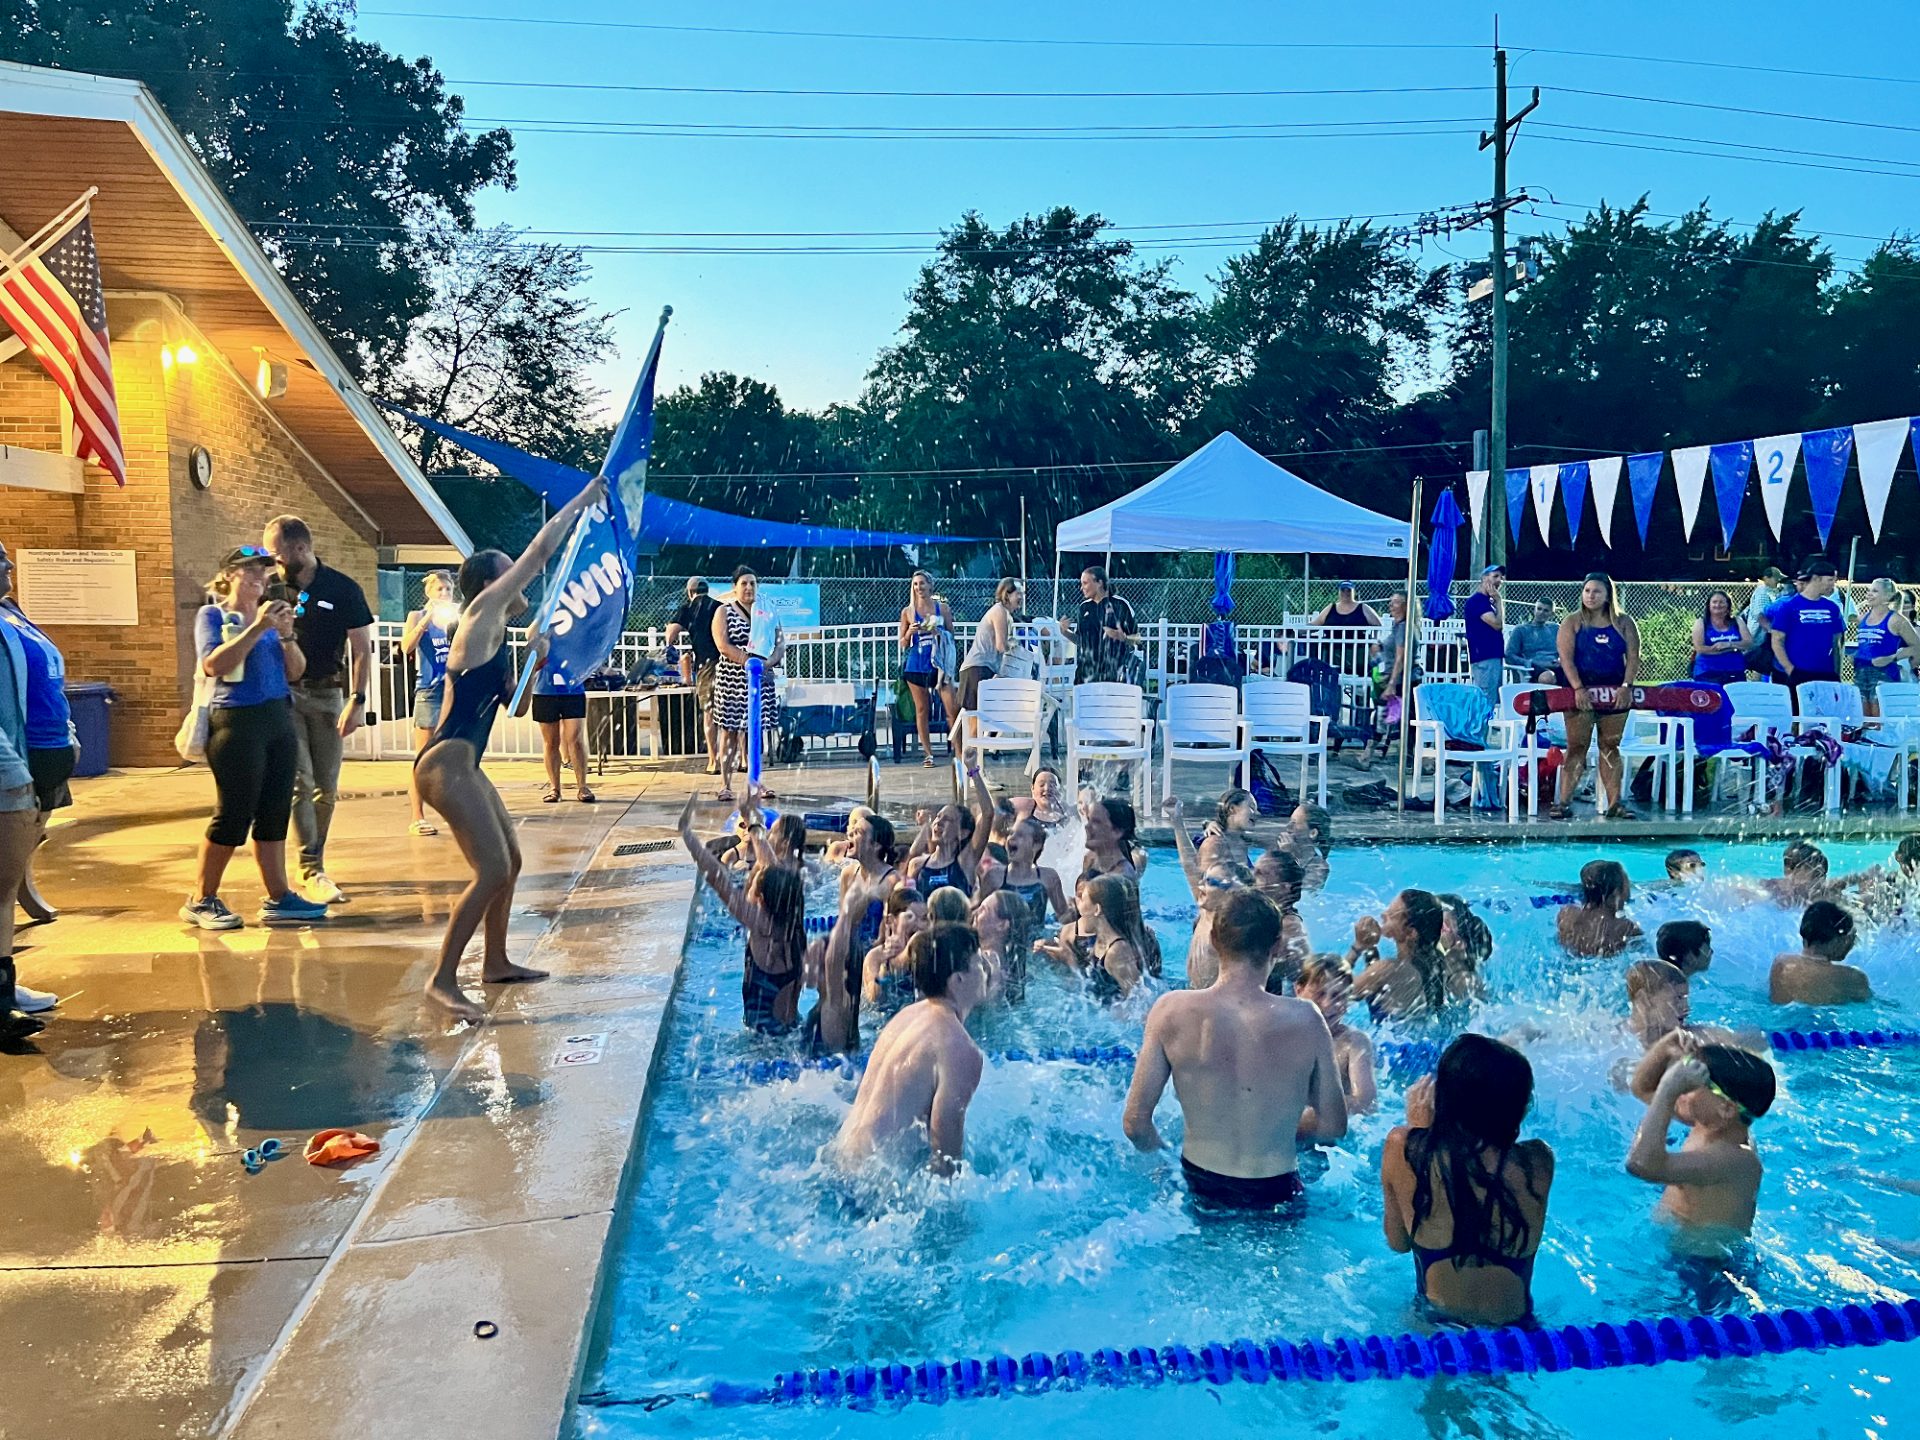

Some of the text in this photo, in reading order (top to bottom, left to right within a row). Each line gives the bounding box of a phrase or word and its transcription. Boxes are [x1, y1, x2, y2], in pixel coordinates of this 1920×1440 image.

[1767, 450, 1784, 484] 2
[1538, 478, 1546, 503] 1
[1588, 687, 1645, 703] GARD
